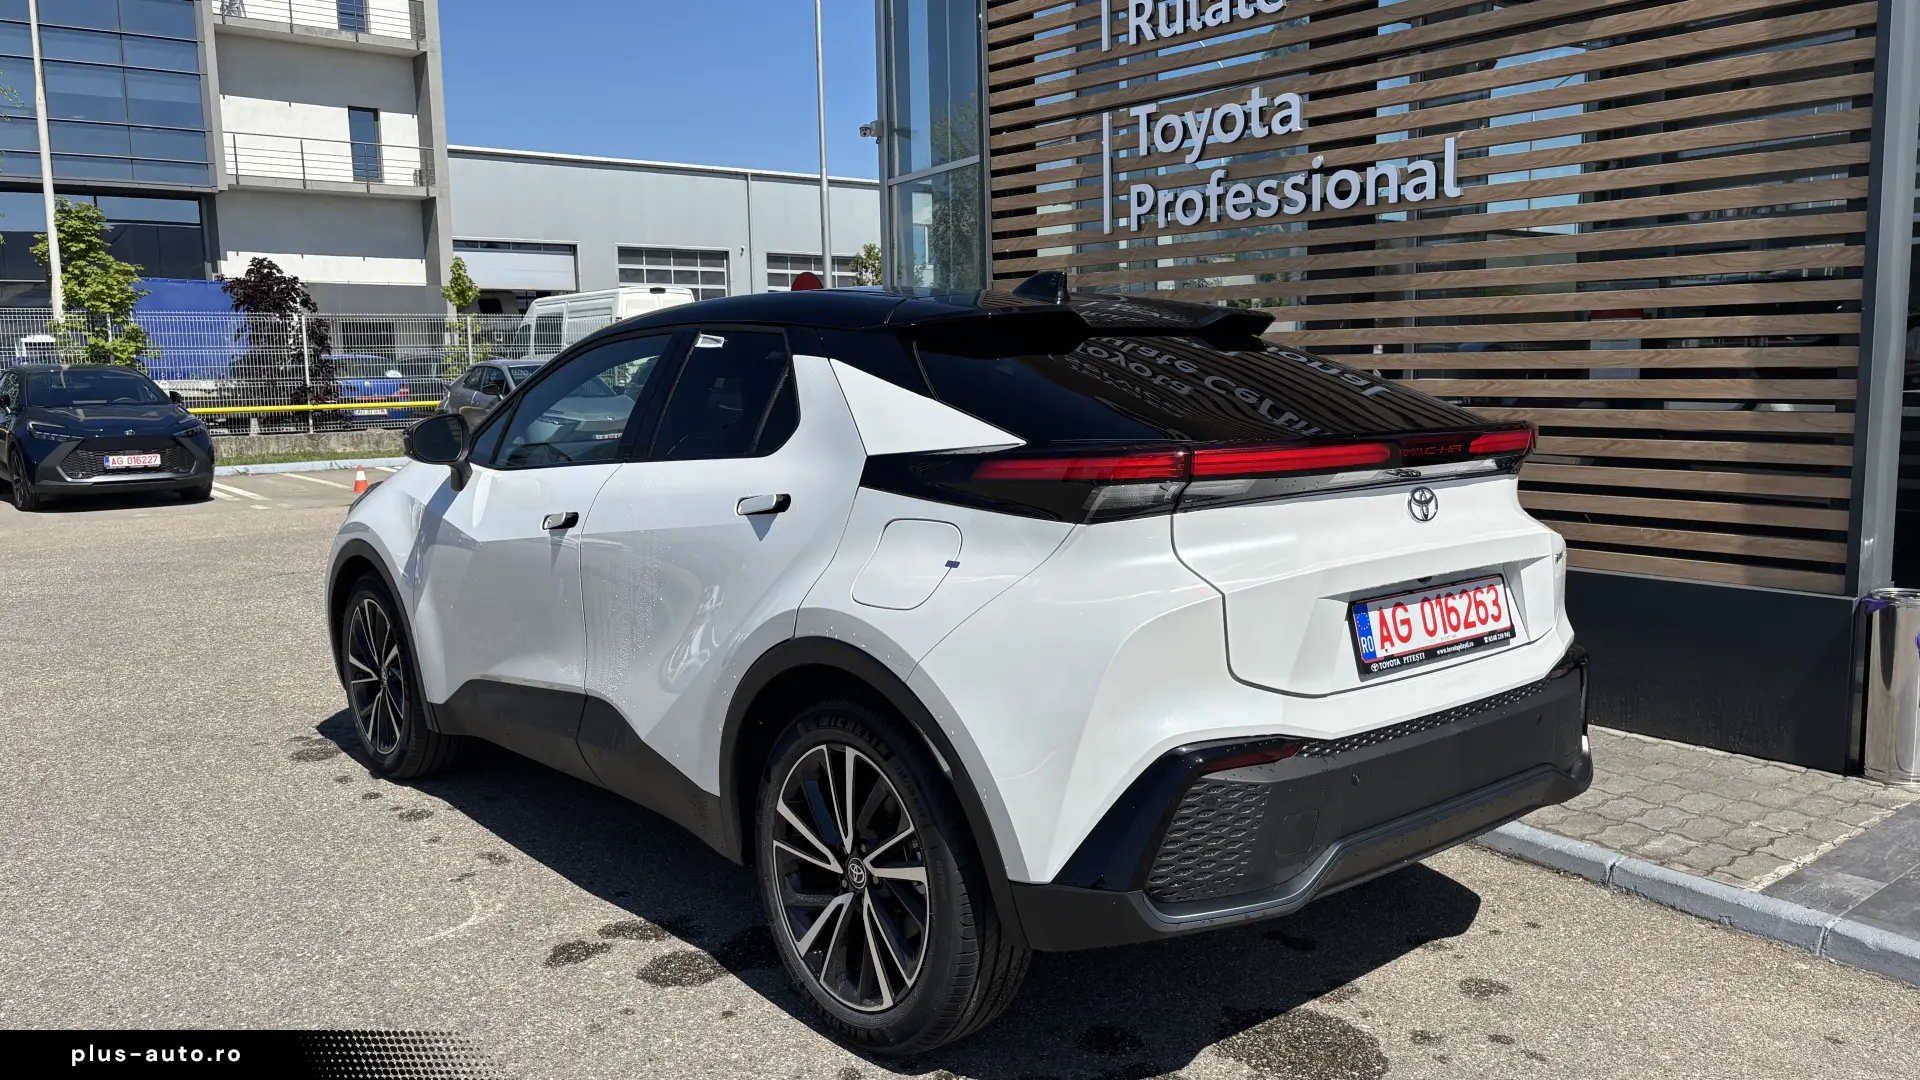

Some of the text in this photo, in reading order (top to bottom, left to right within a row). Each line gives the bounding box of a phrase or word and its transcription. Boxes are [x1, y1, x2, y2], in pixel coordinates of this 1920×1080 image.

[1129, 86, 1304, 164] Toyota
[1130, 137, 1464, 232] Professional
[111, 455, 158, 465] AG 016227
[1379, 584, 1502, 650] AG 016263
[1361, 636, 1375, 653] RO
[1379, 659, 1401, 670] TOYOTA
[819, 714, 890, 756] MICHELIN
